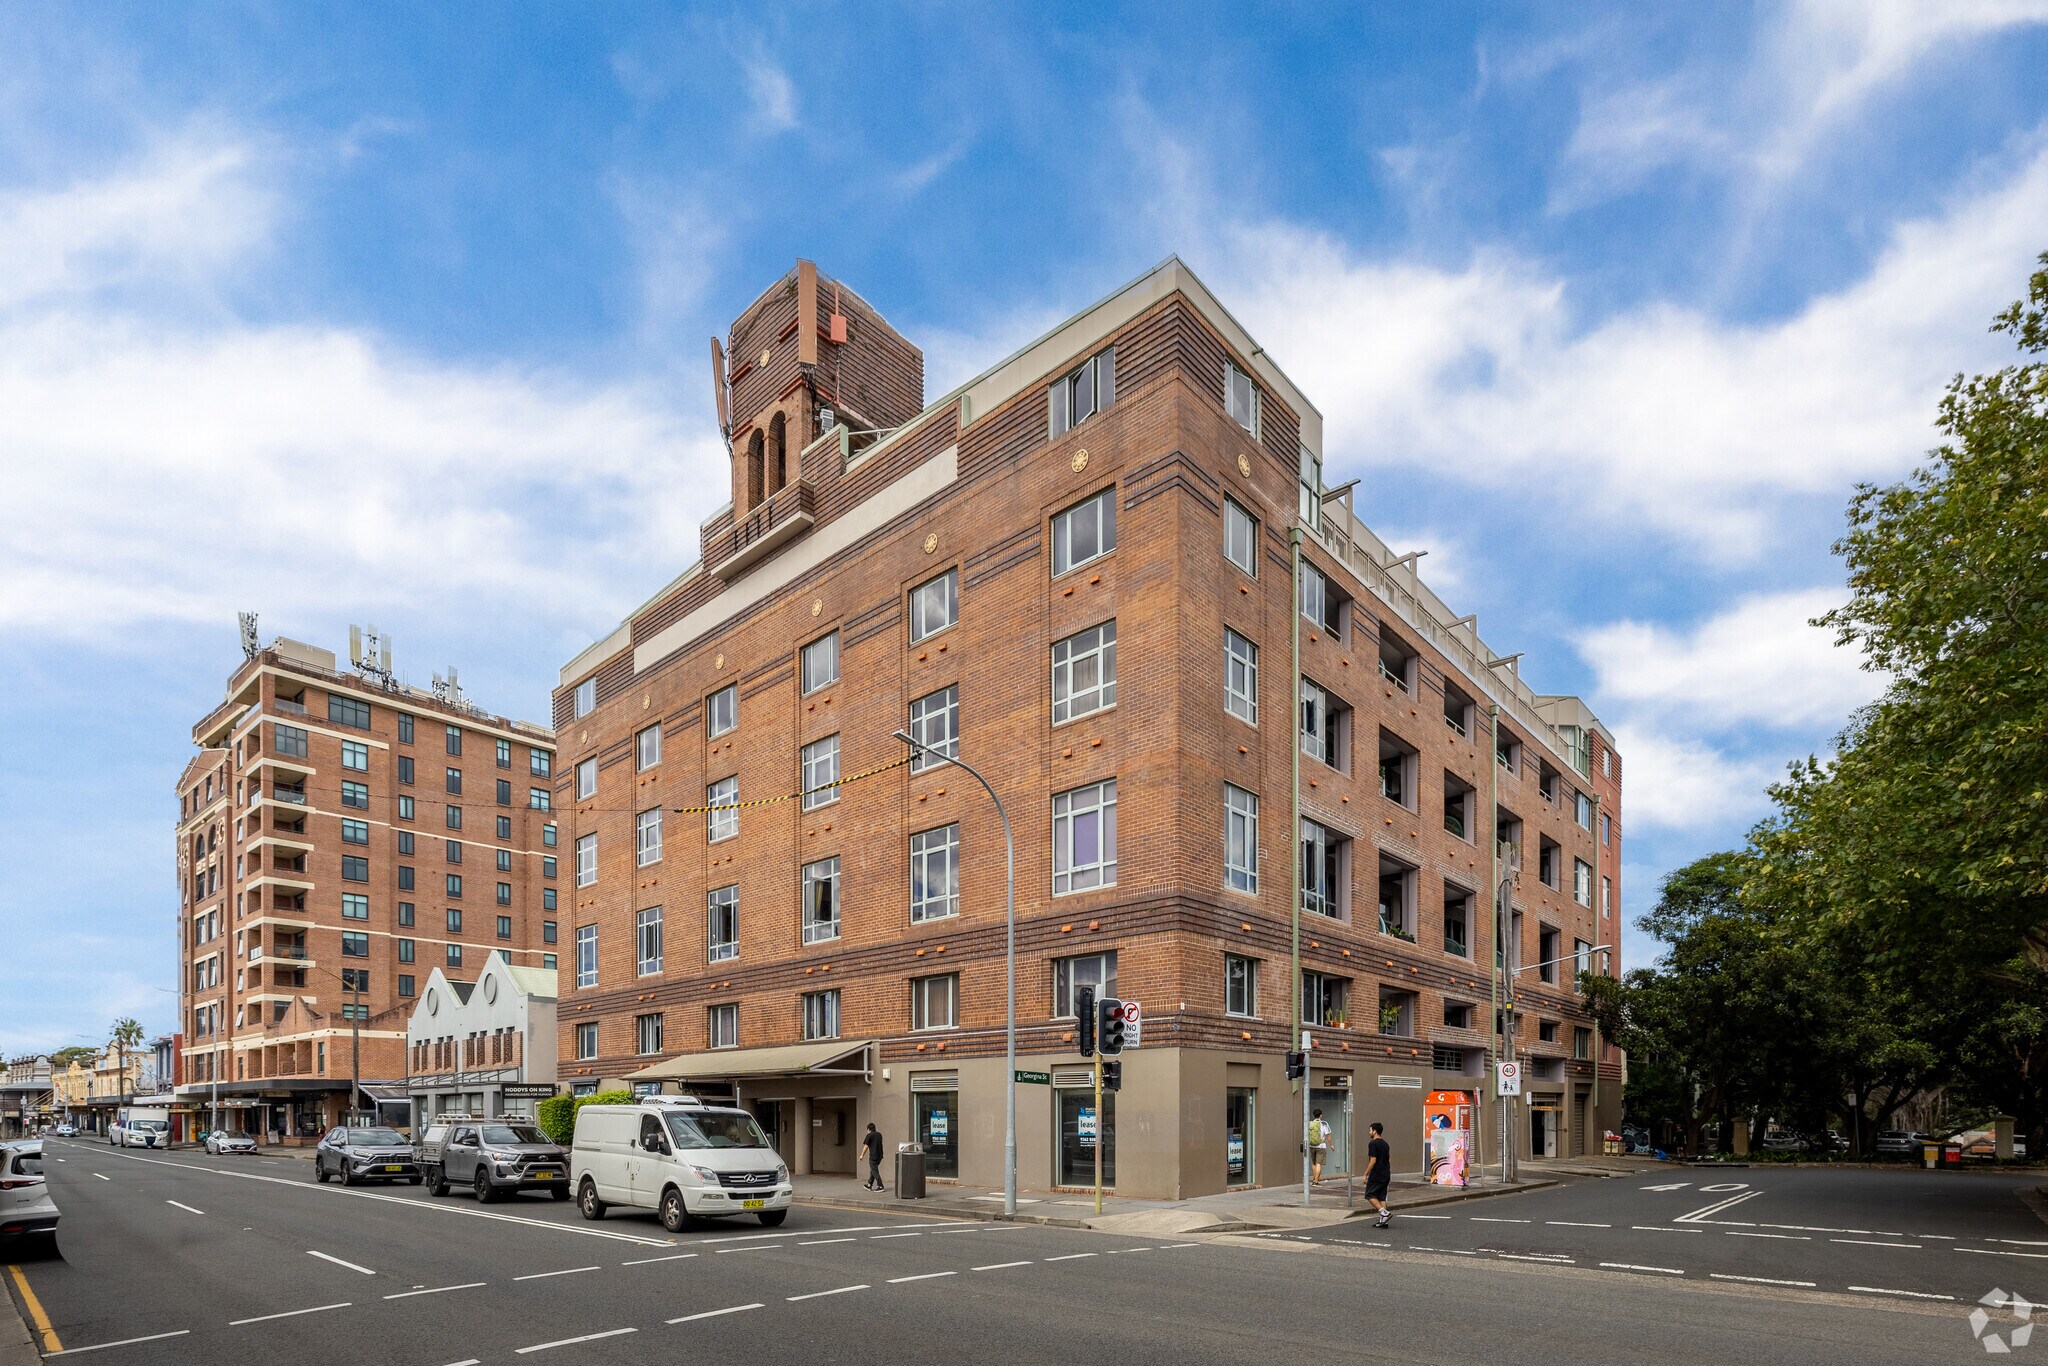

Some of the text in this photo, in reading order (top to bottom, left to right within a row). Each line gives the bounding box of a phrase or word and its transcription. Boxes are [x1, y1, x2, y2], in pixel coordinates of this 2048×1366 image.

[1126, 1024, 1137, 1032] NO
[1023, 1072, 1041, 1080] Georgina
[1638, 1183, 1750, 1191] 40
